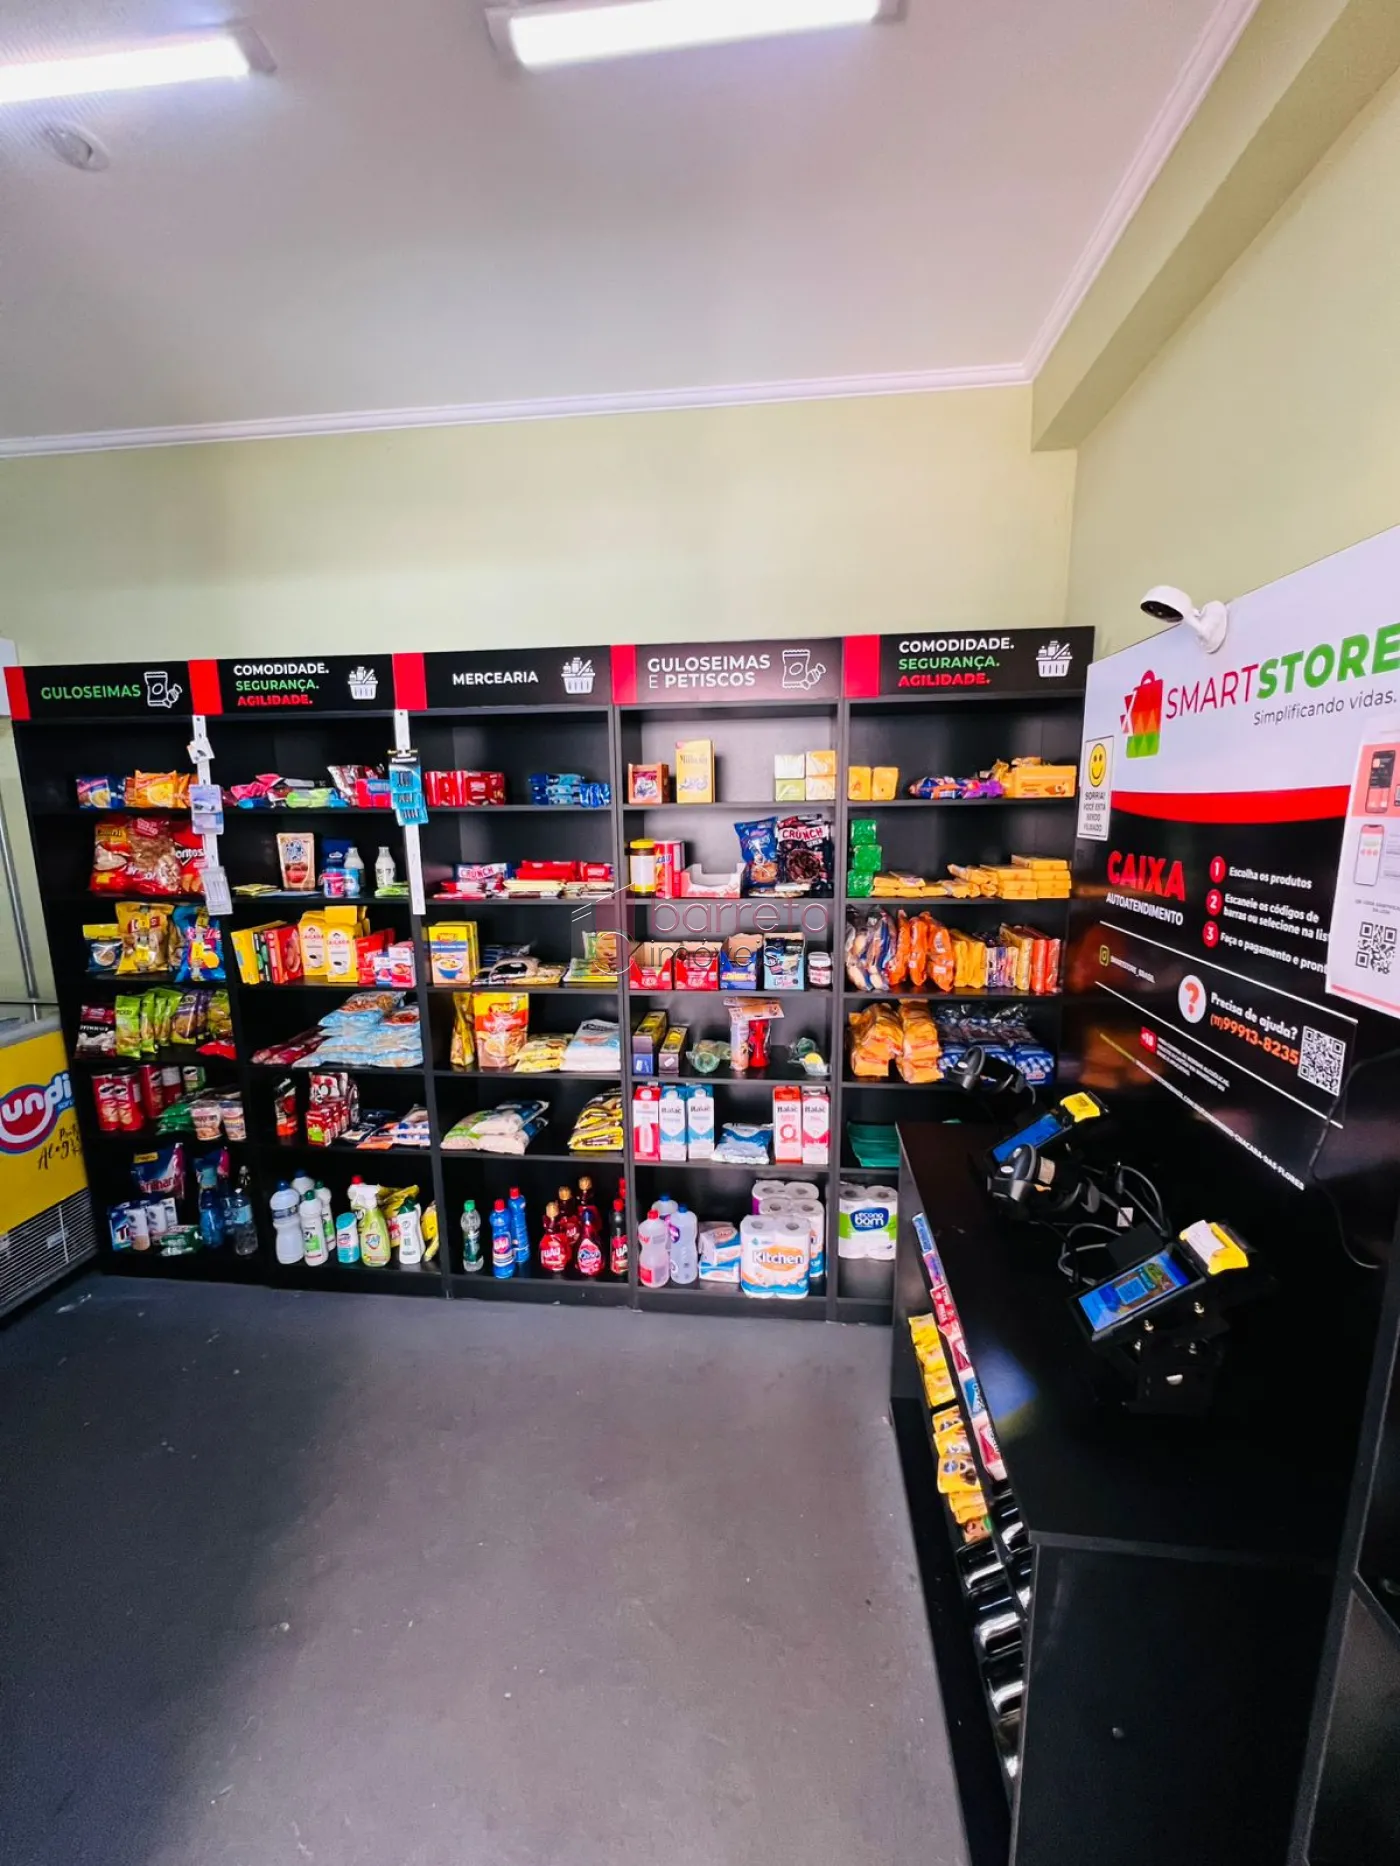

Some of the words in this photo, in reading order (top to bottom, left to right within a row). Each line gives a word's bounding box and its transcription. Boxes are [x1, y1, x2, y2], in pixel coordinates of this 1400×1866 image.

[899, 637, 1015, 653] COMODIDADE.
[233, 662, 330, 676] COMODIDADE.
[647, 654, 771, 673] GULOSEIMAS
[898, 655, 1000, 671] SEGURANÇA.
[235, 679, 320, 692] SEGURANÇA.
[452, 670, 539, 686] MERCEARIA
[649, 675, 659, 689] E
[664, 672, 756, 688] PETISCOS
[898, 673, 991, 688] AGILIDADE.
[40, 684, 141, 700] GULOSEIMAS
[237, 694, 314, 707] AGILIDADE.
[1253, 697, 1345, 726] Simplificando
[1349, 688, 1397, 710] vidas.
[782, 828, 824, 840] CRUNCH
[1107, 850, 1187, 902] CAIXA
[1229, 866, 1259, 880] Escolha
[1259, 873, 1269, 882] os
[1269, 874, 1313, 890] produtos
[1105, 892, 1184, 926] AUTOATENDIMENTO
[1209, 895, 1218, 909] 2
[1224, 893, 1258, 910] Escaneie
[1258, 902, 1269, 912] os
[1269, 903, 1305, 920] códigos
[1306, 911, 1320, 924] de
[1223, 905, 1247, 921] barras
[1247, 914, 1258, 925] ou
[1259, 917, 1301, 935] selecione
[1301, 927, 1314, 939] na
[1206, 926, 1214, 940] 3
[1220, 932, 1238, 947] Faça
[1237, 939, 1244, 948] o
[1244, 940, 1292, 962] pagamento
[1292, 955, 1299, 965] e
[1210, 991, 1243, 1017] Precisa
[1244, 1007, 1257, 1023] de
[1259, 1016, 1298, 1041] ajuda?
[855, 1213, 884, 1227] bom
[752, 1250, 804, 1265] Kitchen
